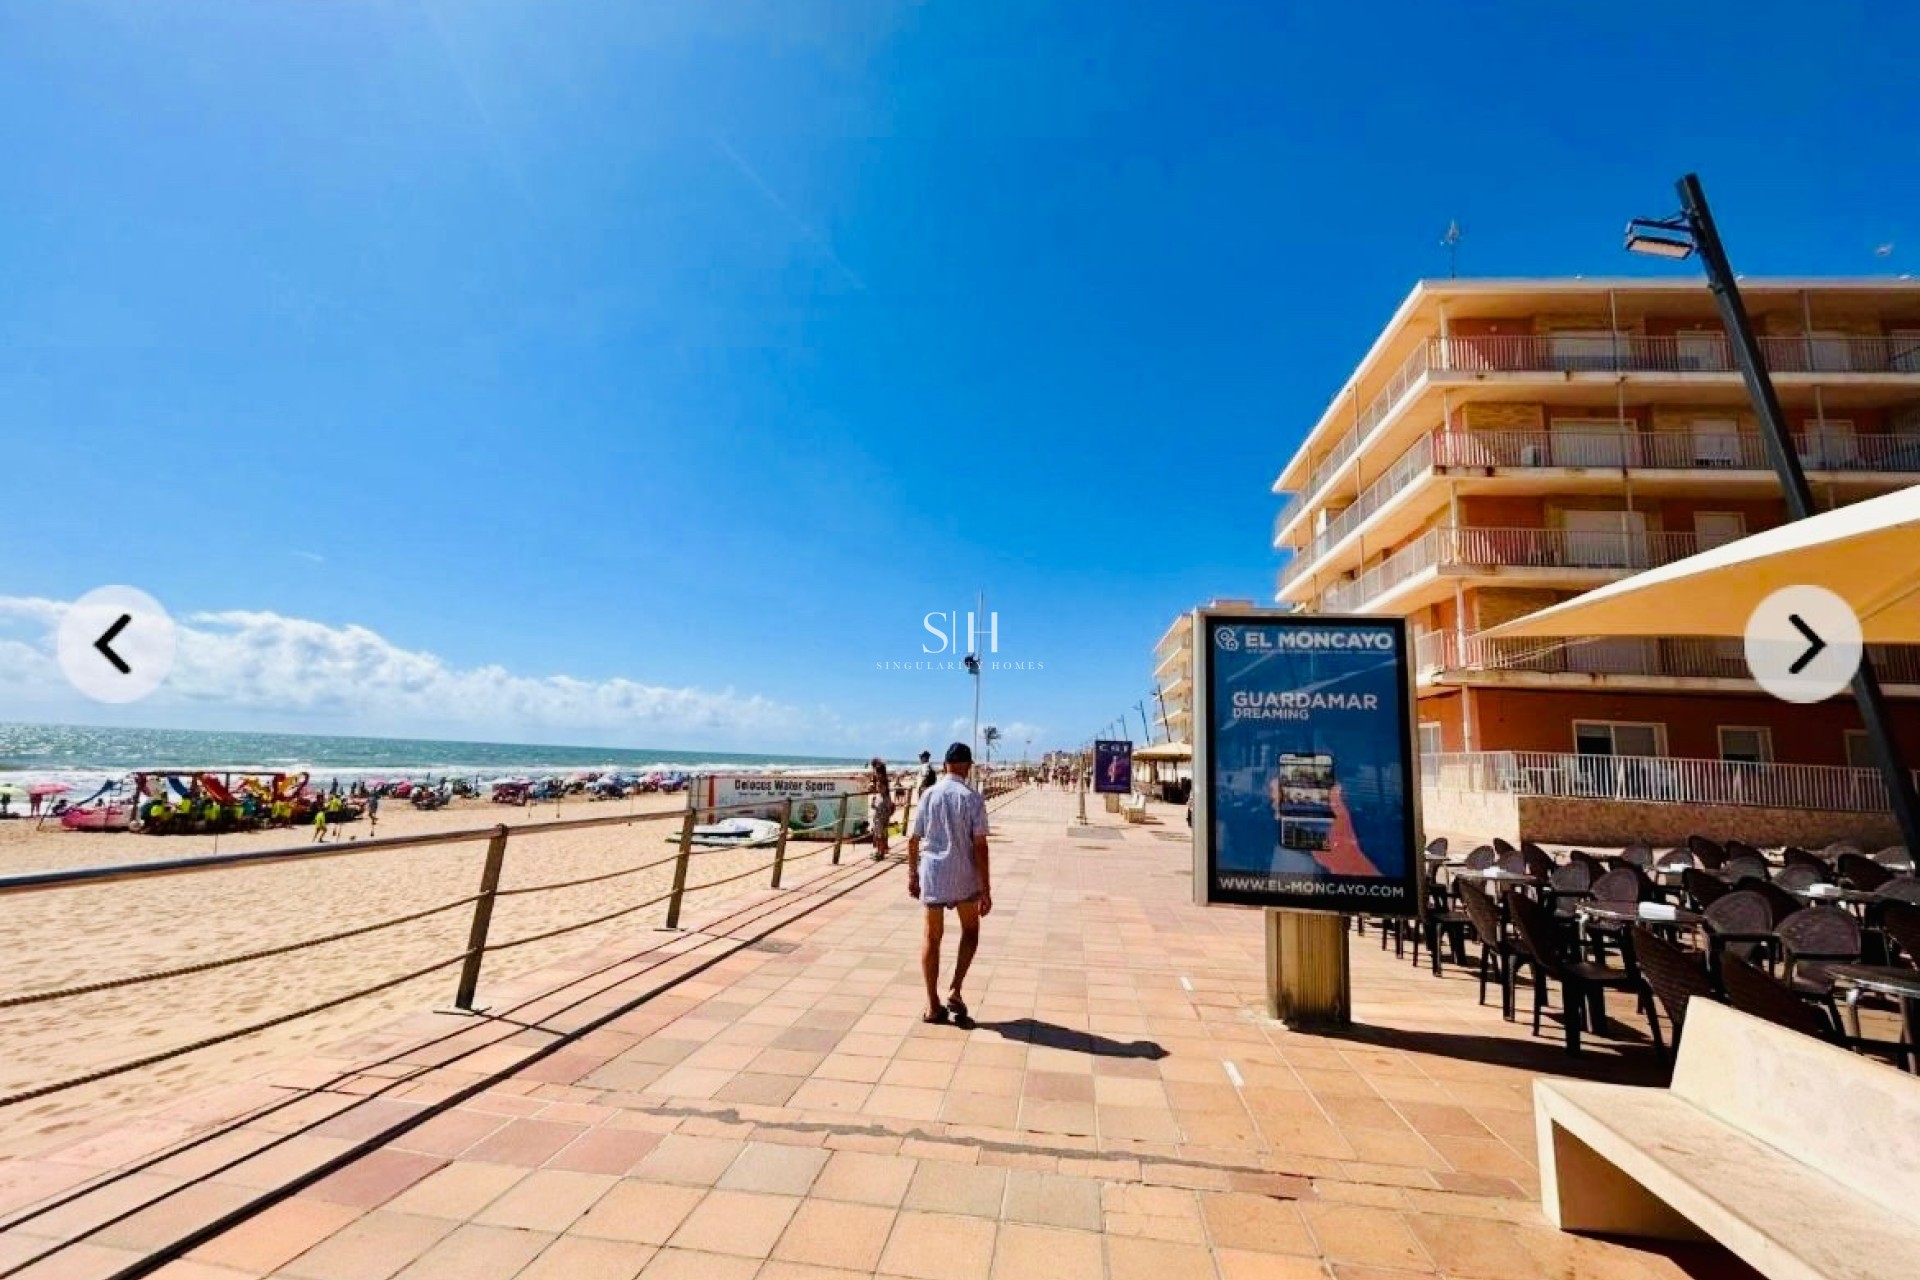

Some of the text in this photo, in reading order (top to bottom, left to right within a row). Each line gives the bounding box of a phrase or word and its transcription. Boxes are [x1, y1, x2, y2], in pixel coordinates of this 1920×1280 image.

[1246, 632, 1393, 650] EL MONCAYO
[1232, 692, 1378, 710] GUARDAMAR
[1232, 708, 1309, 720] DREAMING
[805, 780, 836, 793] Sports
[1219, 877, 1404, 898] WWW.EL-MONCAYO.COM
